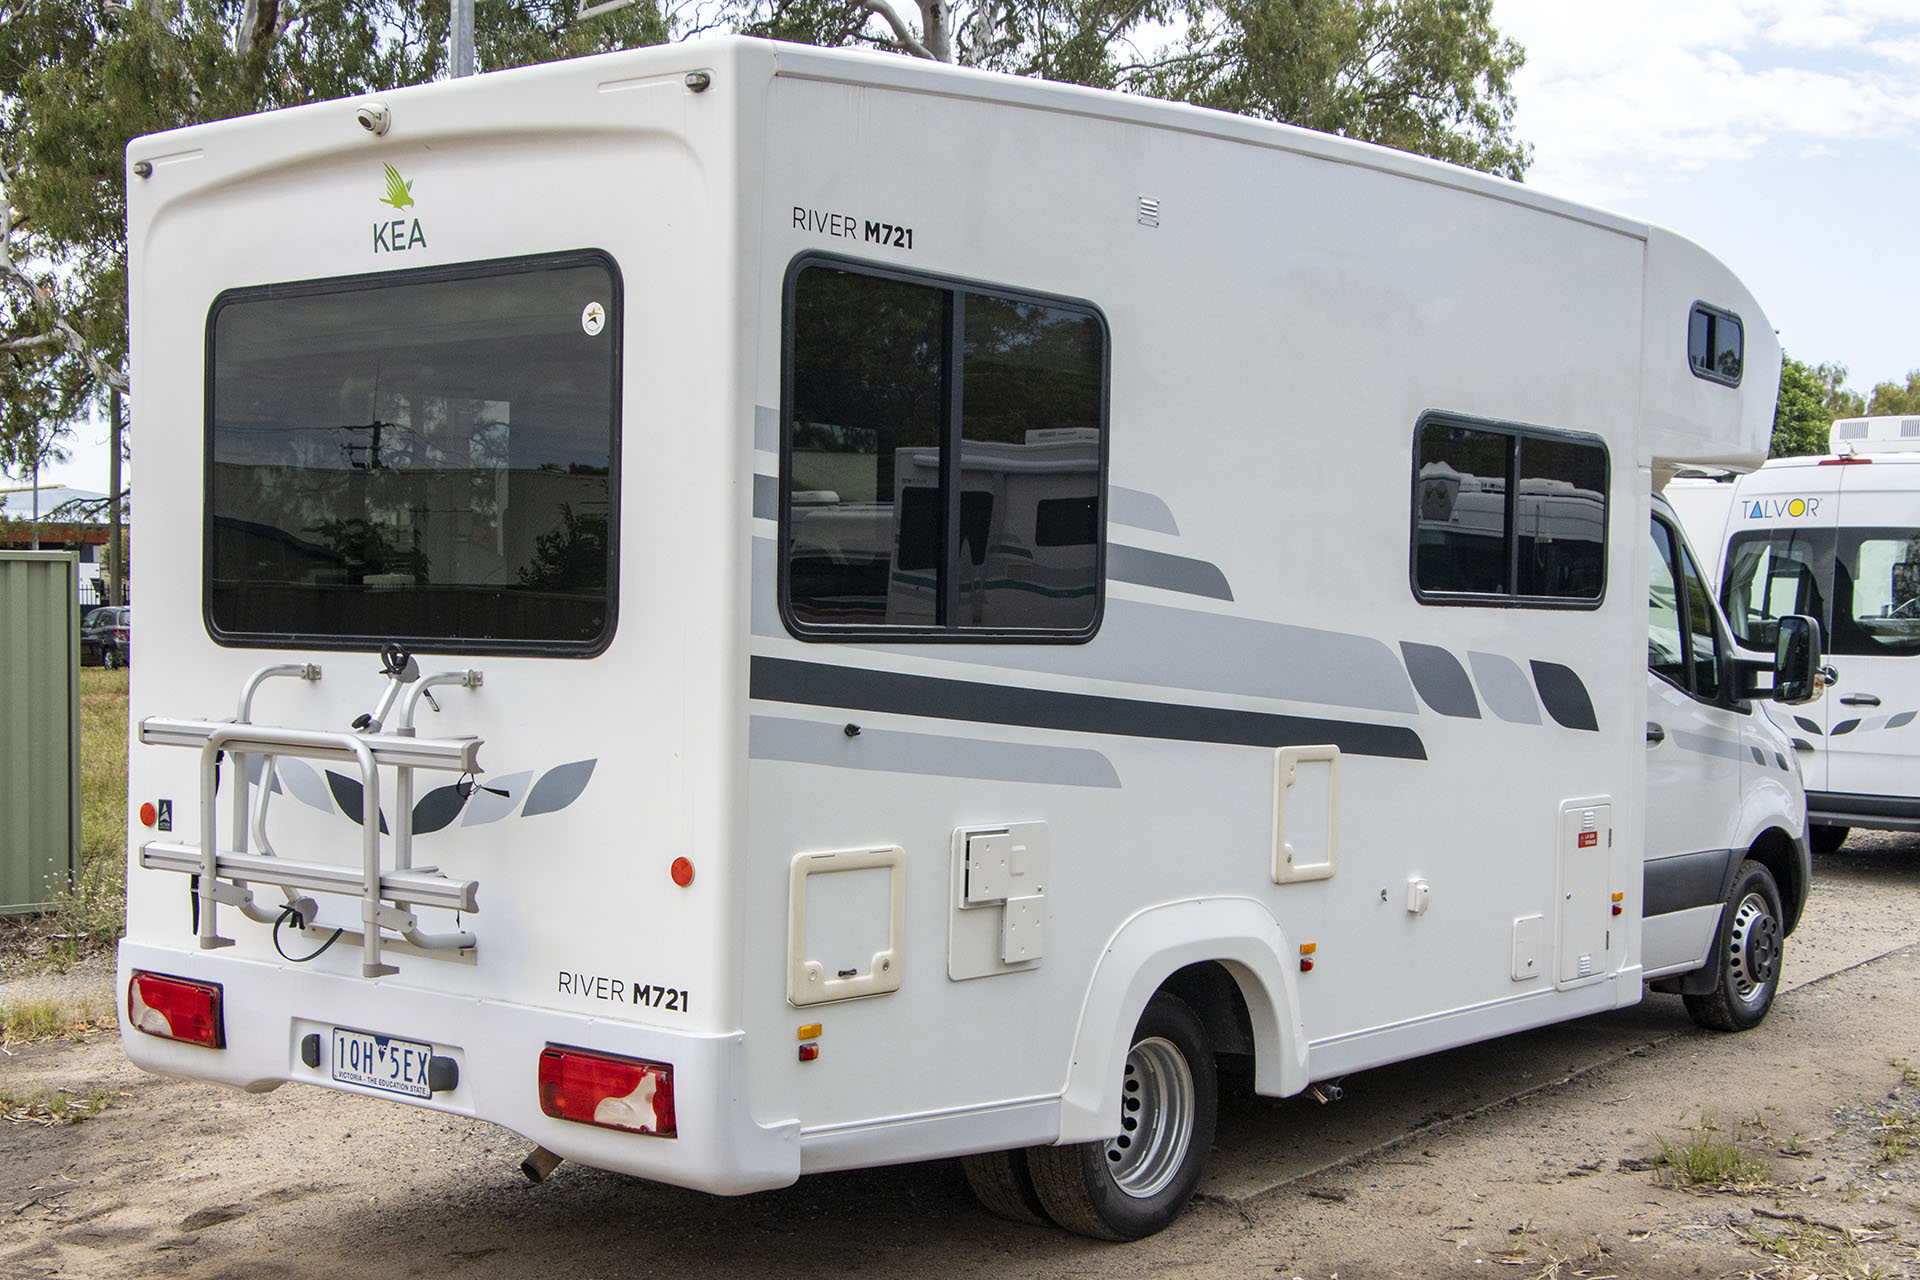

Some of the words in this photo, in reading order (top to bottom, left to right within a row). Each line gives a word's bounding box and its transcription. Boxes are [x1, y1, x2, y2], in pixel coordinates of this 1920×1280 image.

[373, 218, 427, 253] KEA
[793, 206, 856, 239] RIVER
[865, 220, 912, 249] M721
[1742, 498, 1820, 519] TALVOR
[558, 971, 624, 1002] RIVER
[633, 983, 688, 1012] M721
[338, 1071, 362, 1081] VICTORIA
[367, 1076, 377, 1085] THE
[378, 1078, 409, 1091] EDUCATION
[410, 1084, 426, 1095] STATE
[390, 1046, 428, 1085] 5EX
